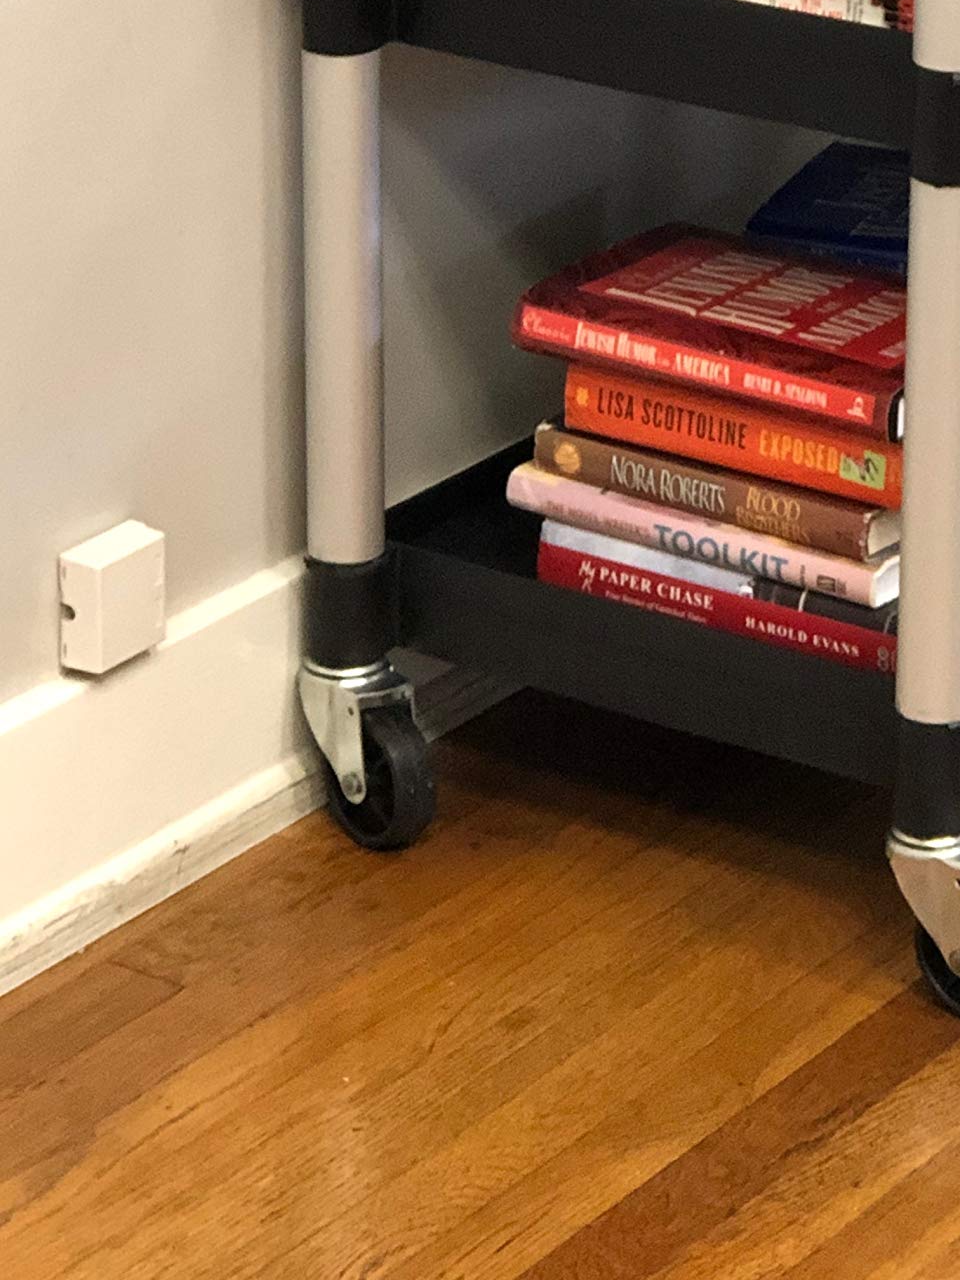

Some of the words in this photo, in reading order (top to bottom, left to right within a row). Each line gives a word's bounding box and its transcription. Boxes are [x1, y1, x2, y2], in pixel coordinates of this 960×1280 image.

[675, 352, 730, 386] AMERICA
[597, 387, 634, 421] LISA
[641, 398, 748, 450] SCOTTOLINE
[759, 429, 839, 475] EXPOSED
[610, 454, 657, 496] NORA
[660, 469, 726, 514] ROBERTS
[653, 523, 789, 582] TOOLKIT
[599, 566, 652, 594] PAPER
[656, 582, 713, 610] CHASE
[745, 616, 807, 643] HAROLD
[812, 634, 860, 657] EVANS
